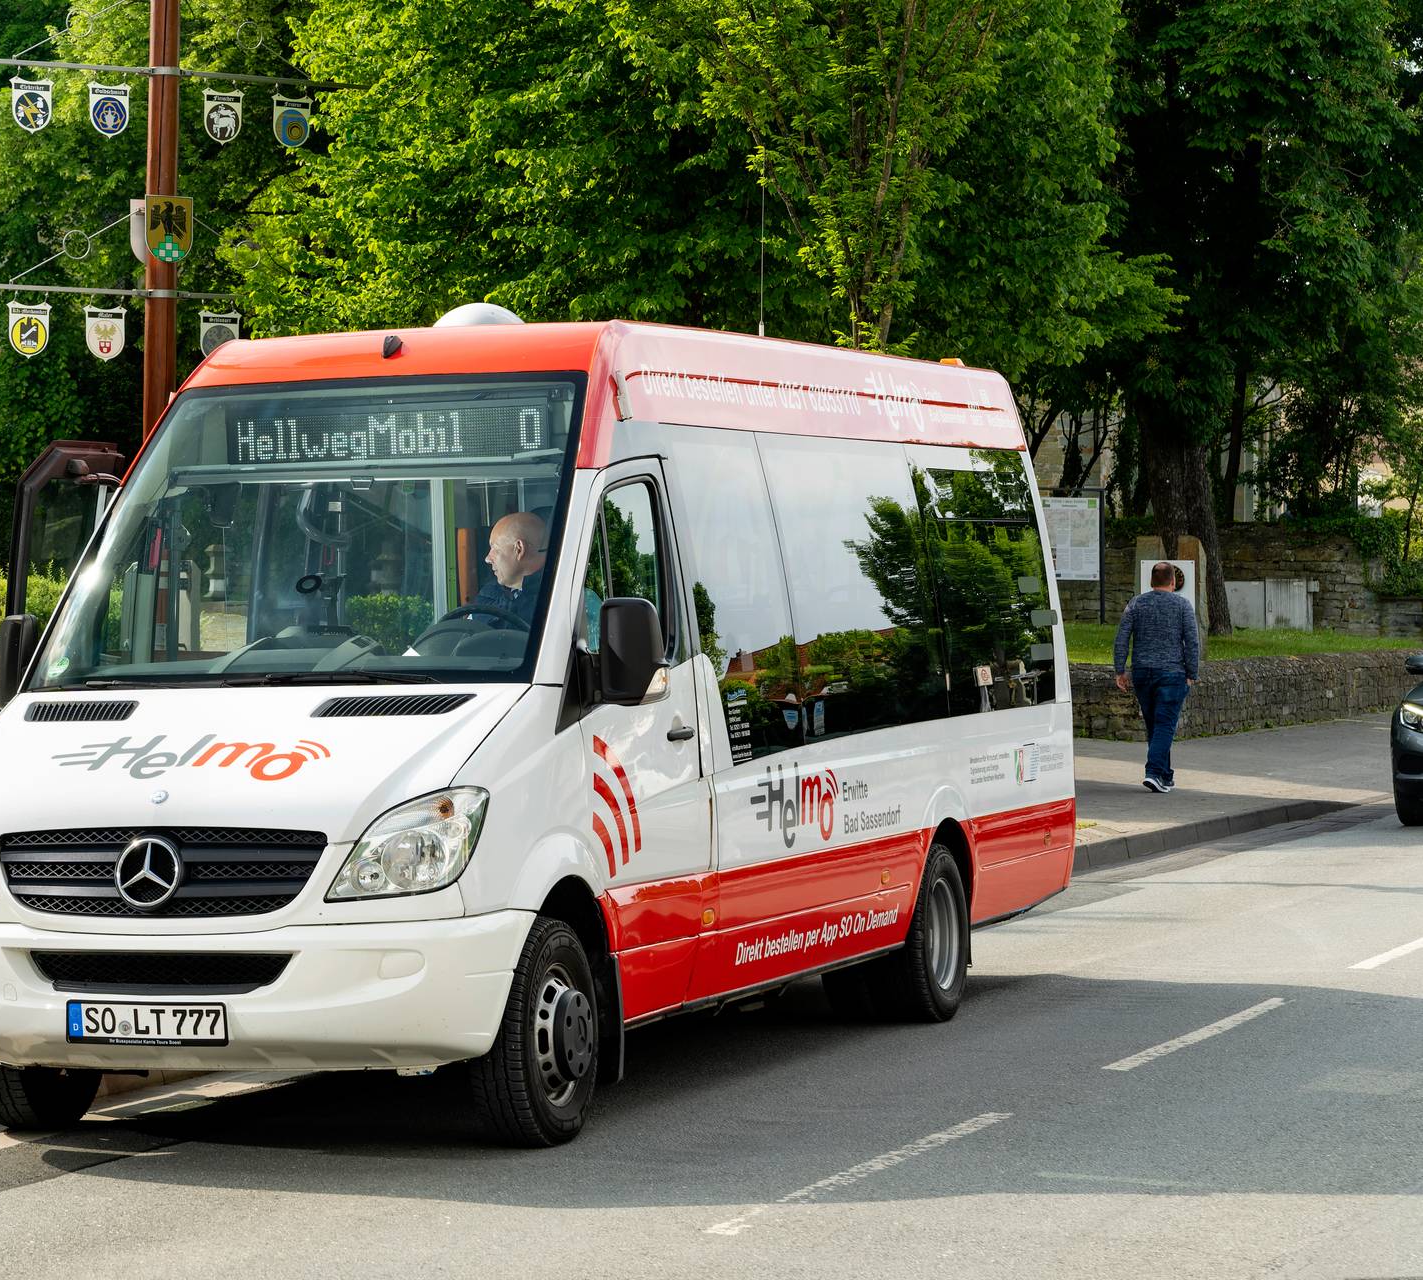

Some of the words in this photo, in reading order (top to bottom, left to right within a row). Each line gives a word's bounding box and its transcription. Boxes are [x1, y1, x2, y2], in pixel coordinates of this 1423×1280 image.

[640, 363, 684, 398] Direkt
[682, 368, 744, 405] bestellen
[744, 380, 778, 408] unter
[237, 411, 464, 462] HellwegMobil
[519, 407, 542, 450] 0
[77, 734, 312, 781] Helmo
[756, 762, 836, 848] Helmo
[842, 780, 869, 802] Erwitte
[844, 811, 859, 834] Bad
[860, 804, 901, 832] Sassendorf
[735, 938, 764, 966] Direkt
[763, 930, 803, 958] bestellen
[803, 928, 821, 952] per
[819, 922, 838, 947] App
[839, 914, 853, 938] SO
[853, 912, 865, 934] On
[866, 903, 899, 931] Demand
[85, 1007, 116, 1034] SO
[133, 1008, 166, 1035] LT
[172, 1009, 221, 1036] 777
